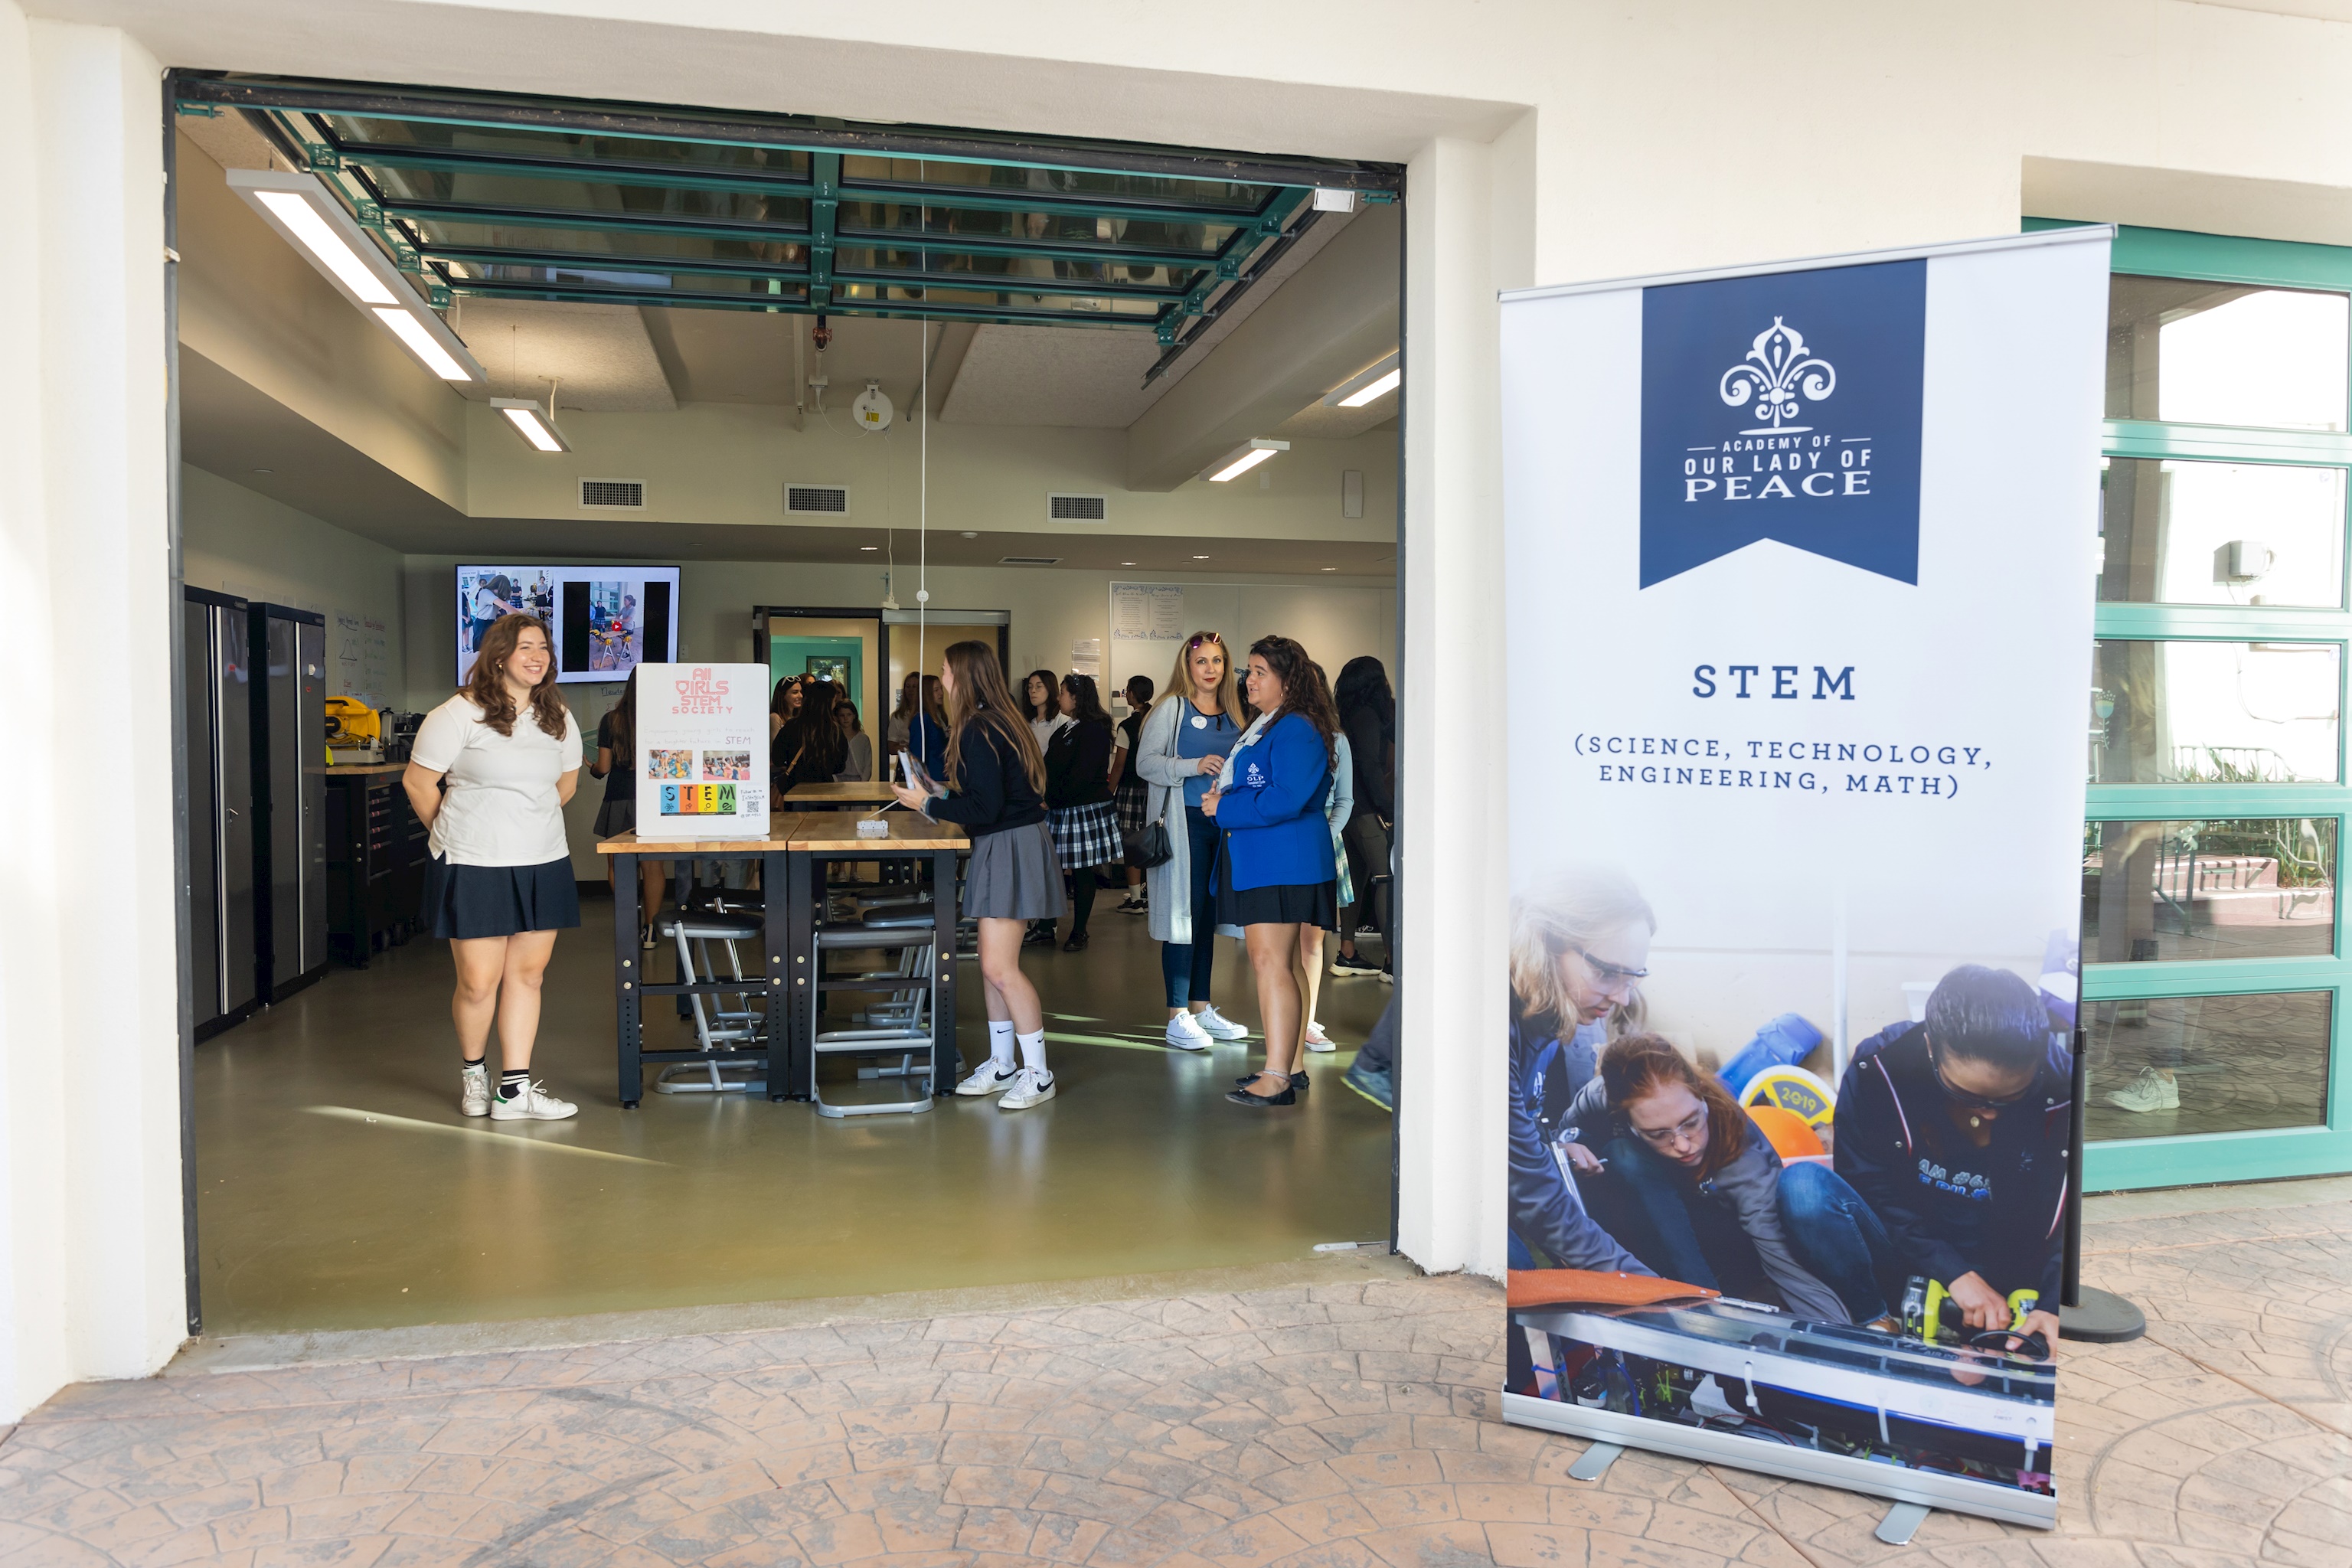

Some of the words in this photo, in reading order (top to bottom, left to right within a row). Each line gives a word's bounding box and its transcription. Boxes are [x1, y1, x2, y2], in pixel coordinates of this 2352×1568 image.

[1723, 436, 1802, 452] ACADEMY
[1812, 435, 1831, 448] OF
[1684, 456, 1734, 476] OUR
[1753, 452, 1821, 472] LADY
[1841, 449, 1871, 469] OF
[1684, 470, 1870, 502] PEACE
[1693, 665, 1855, 701] STEM
[672, 706, 733, 714] SOCIETY
[681, 695, 721, 706] STEM
[725, 736, 751, 745] STEM
[1574, 733, 1731, 761] (SCIENCE,
[1747, 740, 1991, 770] TECHNOLOGY,
[665, 785, 735, 802] STEM
[1599, 765, 1828, 794] ENGINEERING,
[1846, 774, 1958, 799] MATH)
[1782, 1086, 1817, 1112] 2019
